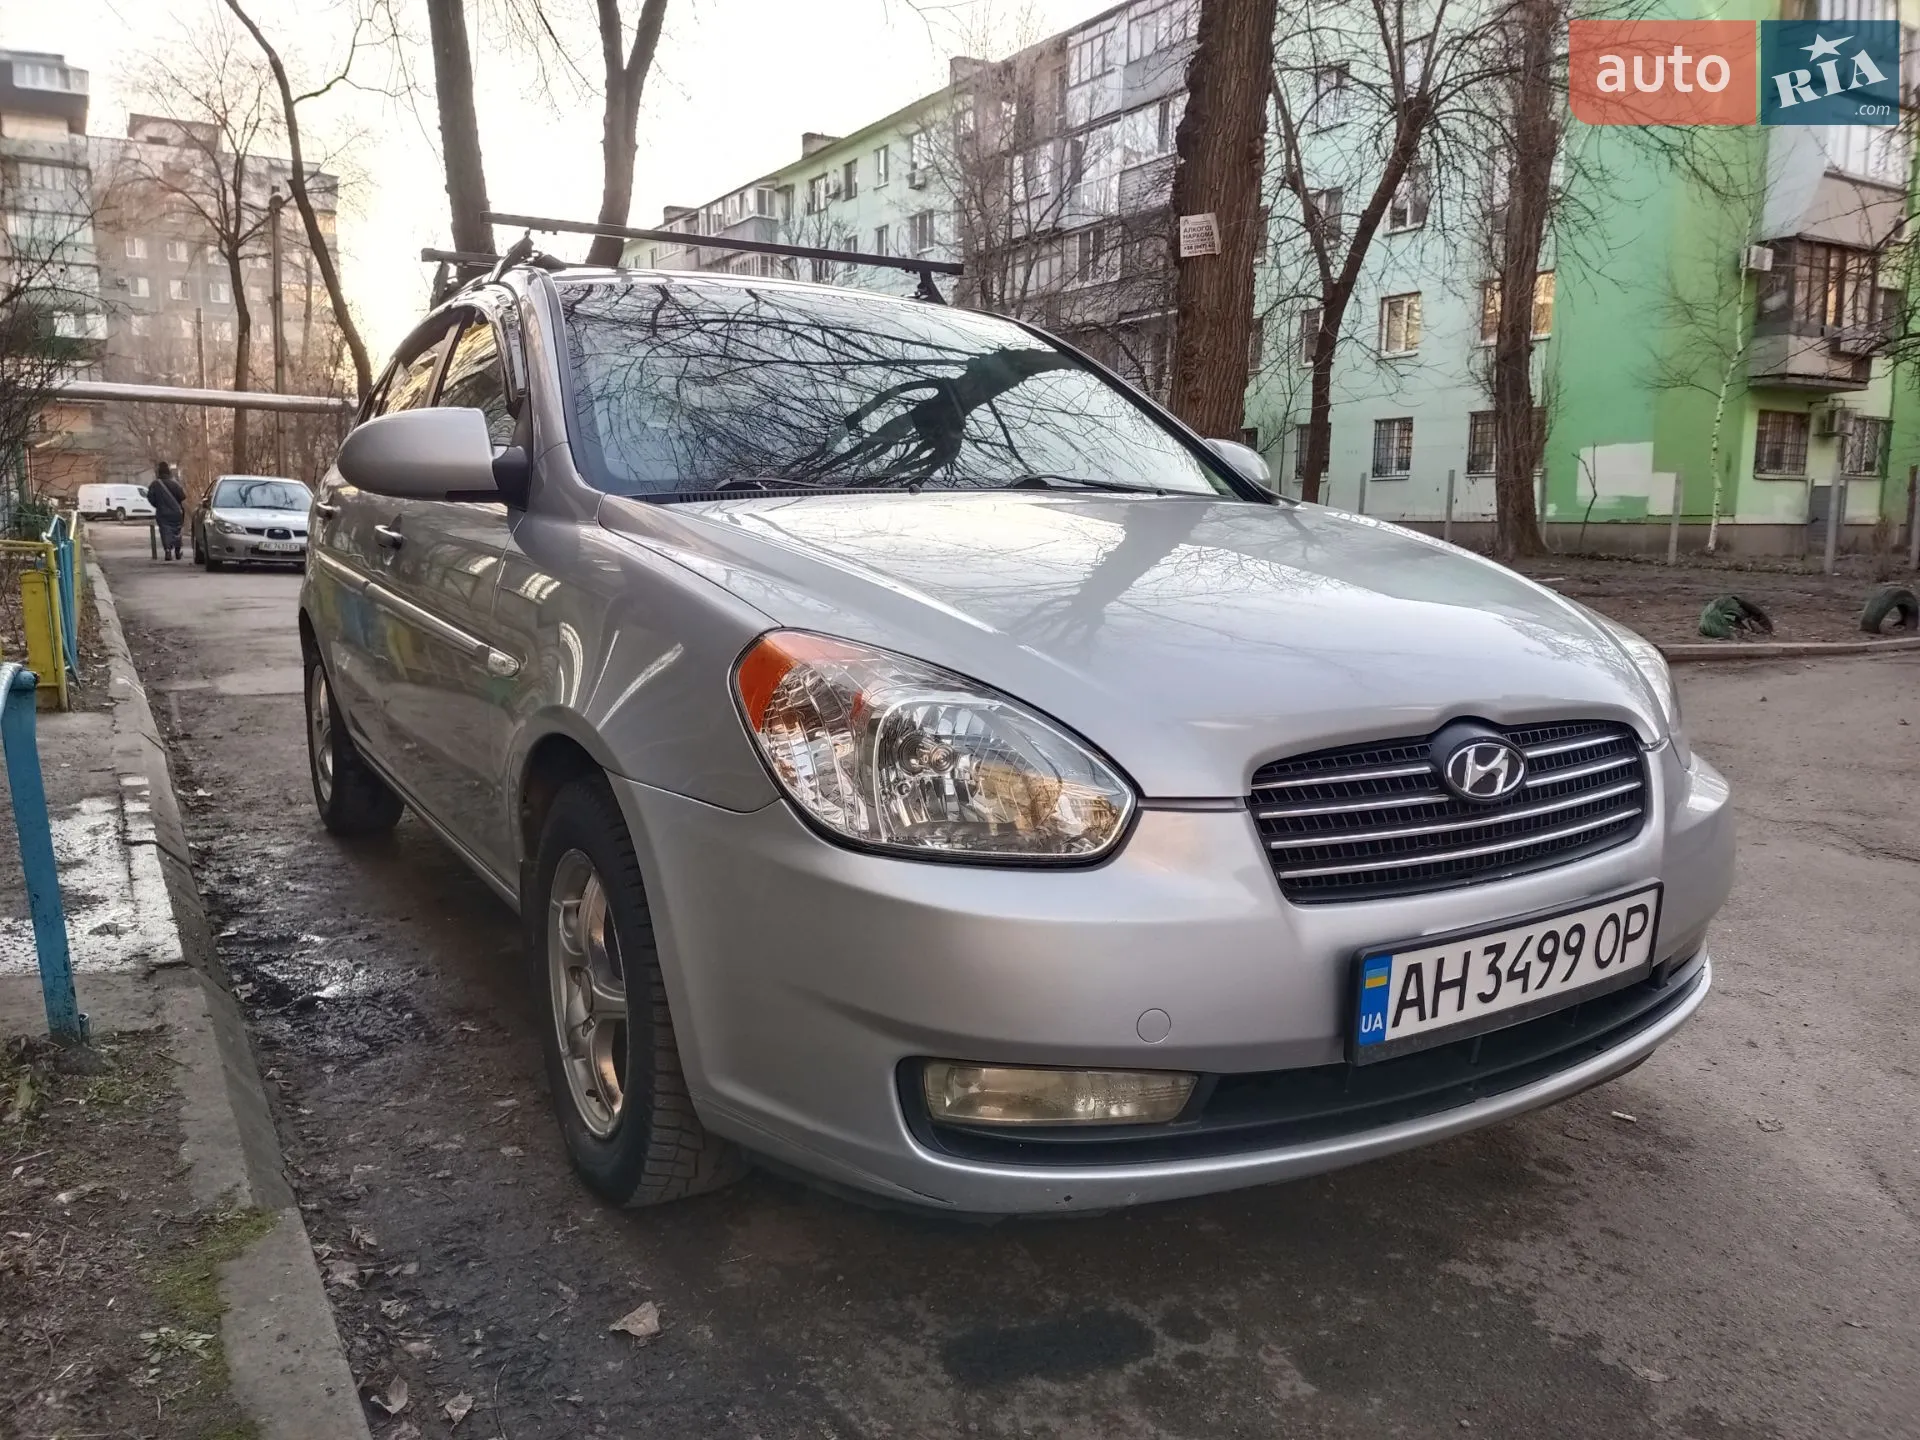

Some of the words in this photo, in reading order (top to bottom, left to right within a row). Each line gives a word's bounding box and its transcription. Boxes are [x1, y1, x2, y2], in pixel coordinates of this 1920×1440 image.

[1391, 950, 1472, 1028] AH
[1477, 923, 1586, 1004] 3499
[1594, 903, 1649, 969] OP
[1361, 1012, 1384, 1033] UA
